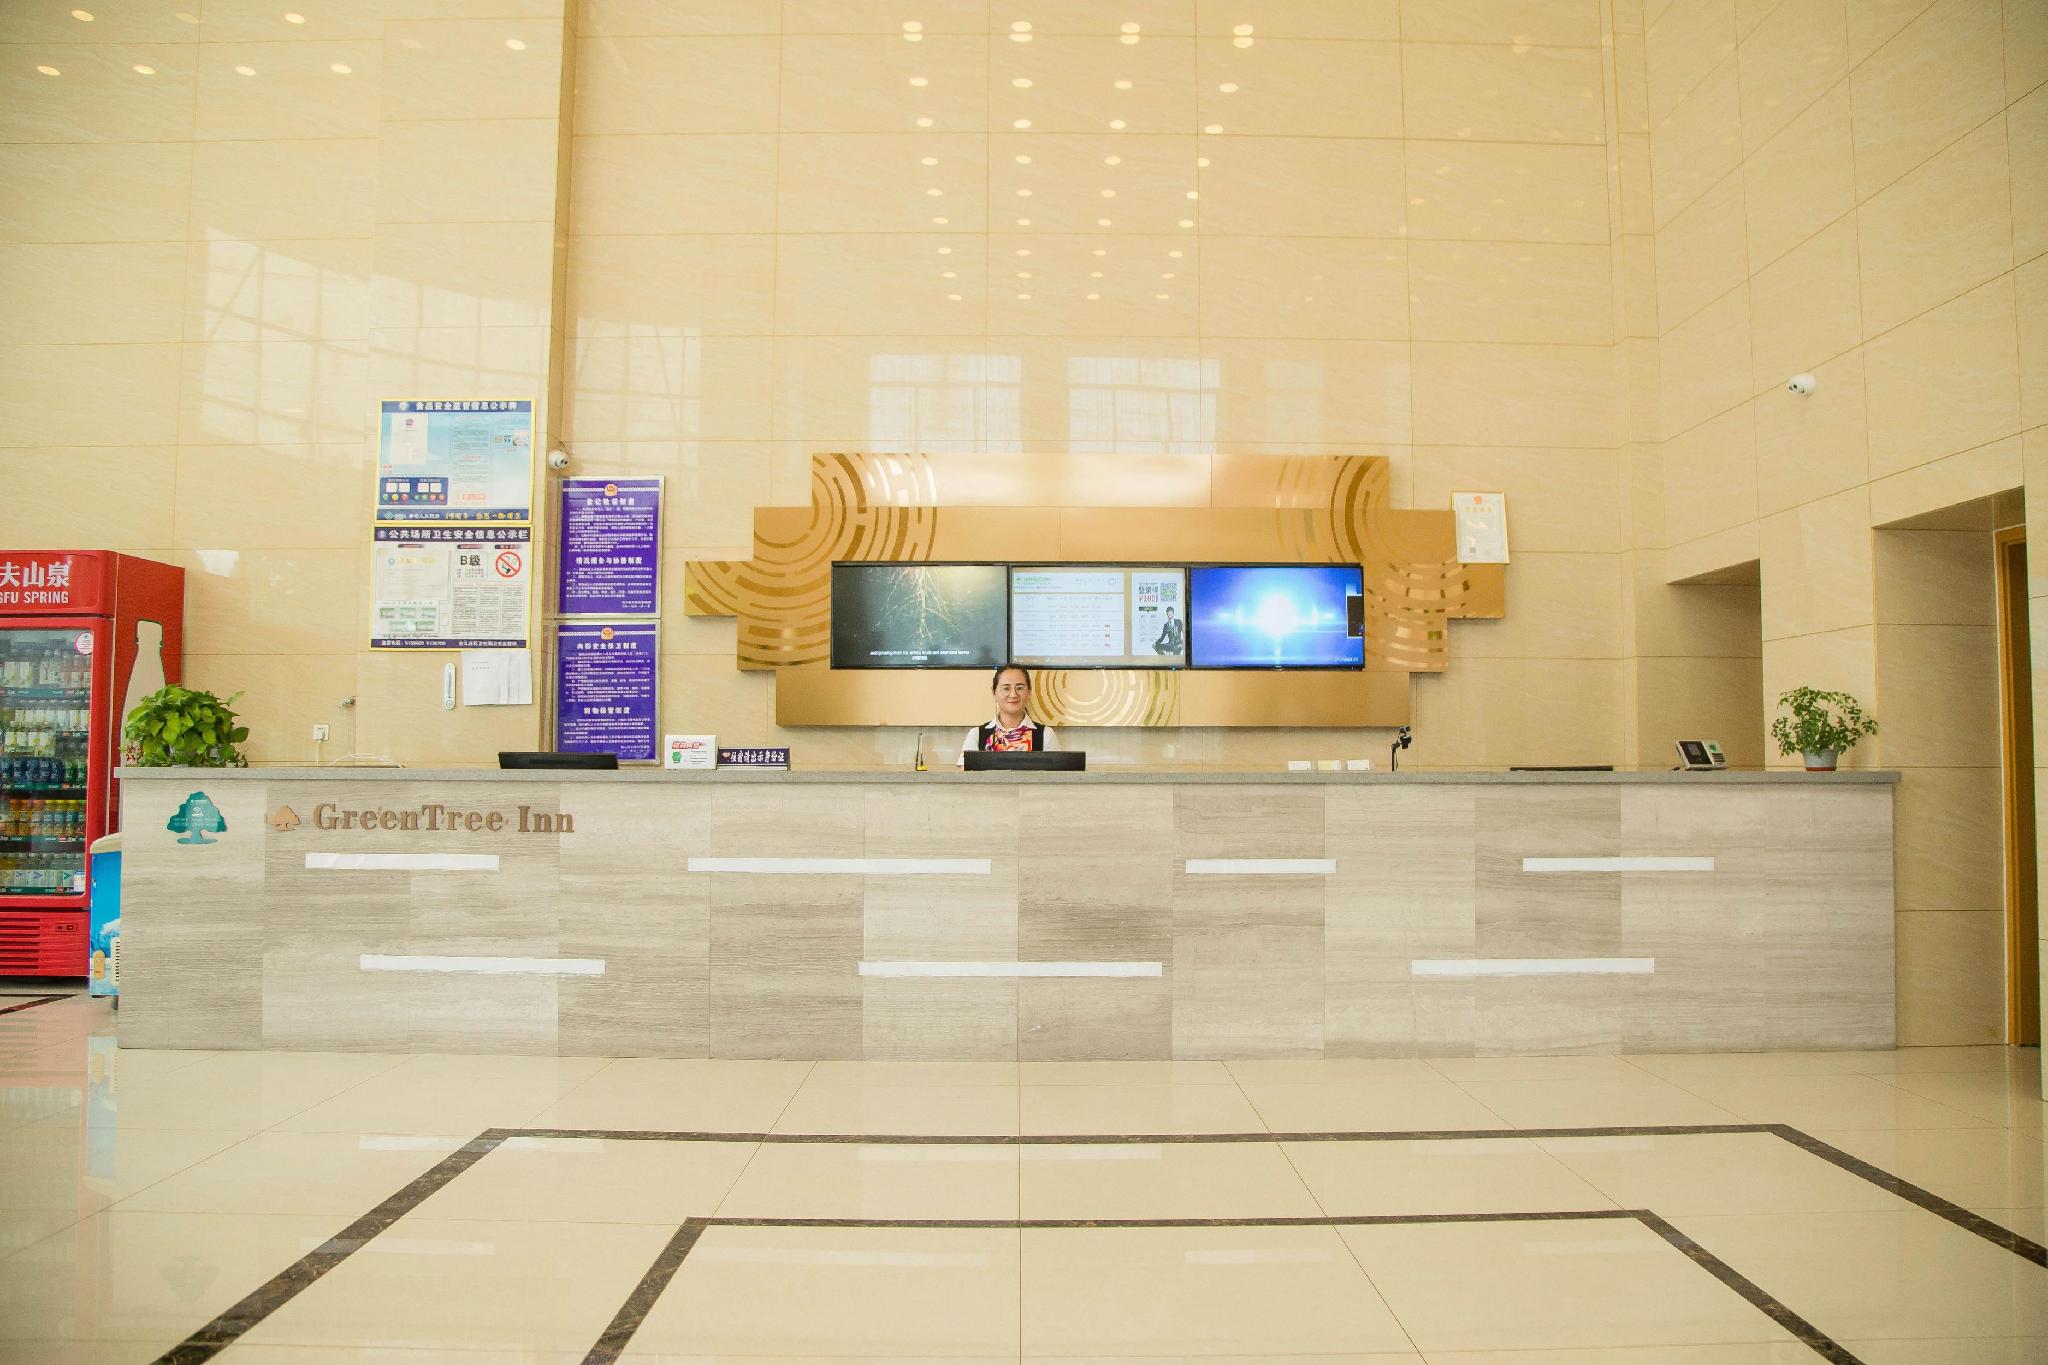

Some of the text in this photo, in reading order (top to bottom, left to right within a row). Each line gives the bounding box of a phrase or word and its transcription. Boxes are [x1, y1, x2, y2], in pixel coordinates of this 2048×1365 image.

[389, 529, 528, 540] 公共场所卫生安全信息公示栏
[460, 554, 481, 567] B级
[23, 591, 69, 604] SPRING
[313, 803, 574, 833] GreenTree Inn
